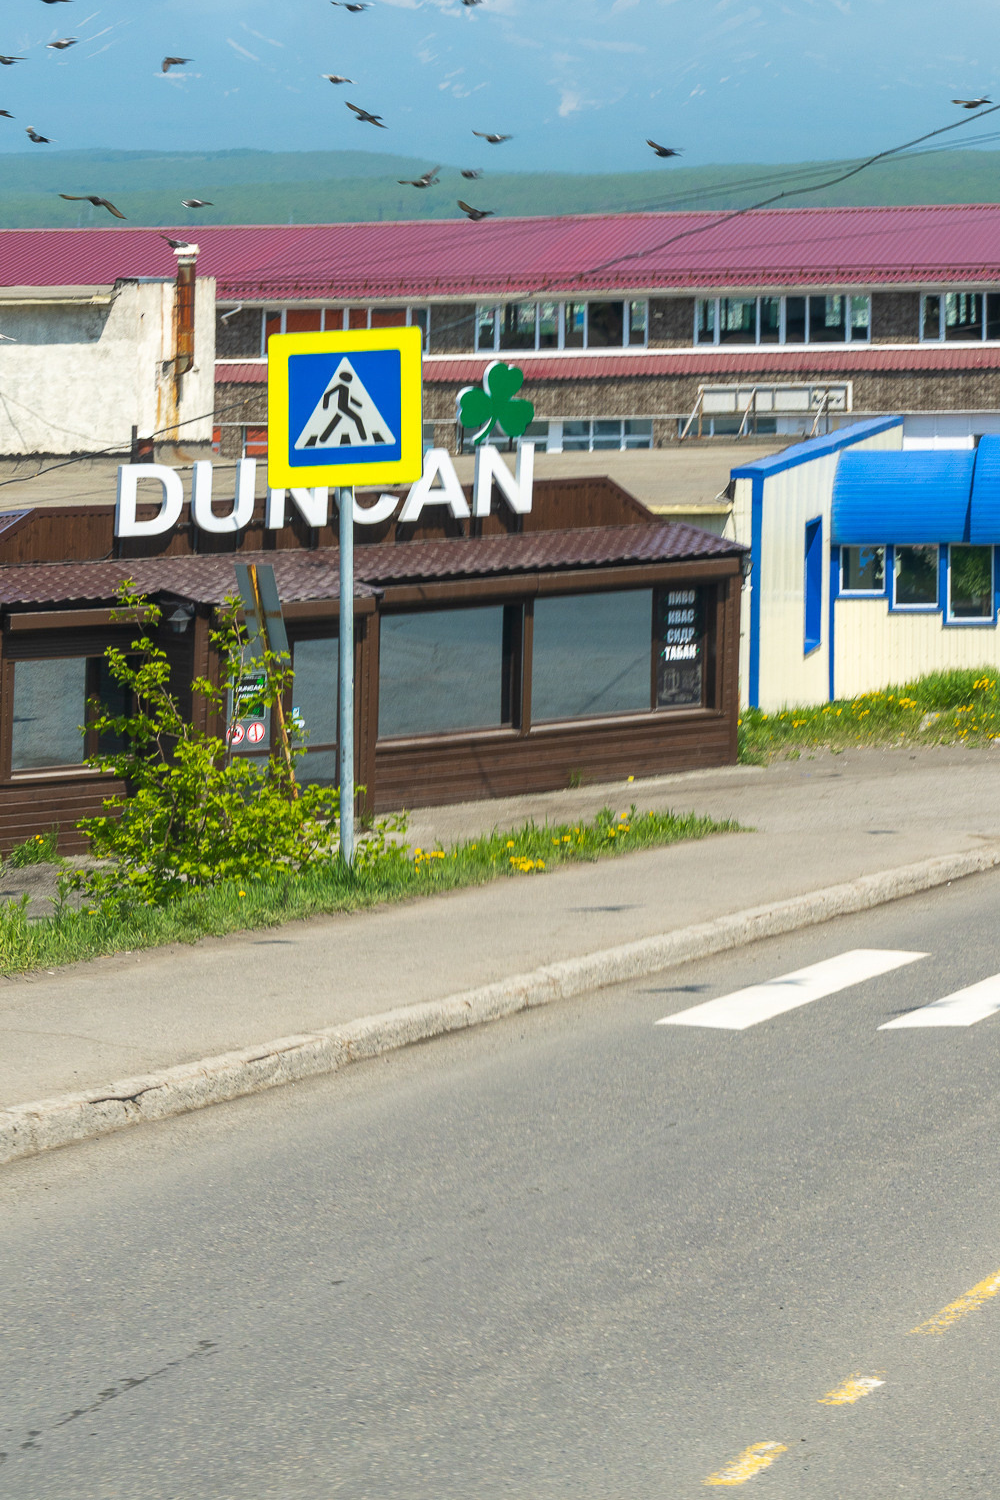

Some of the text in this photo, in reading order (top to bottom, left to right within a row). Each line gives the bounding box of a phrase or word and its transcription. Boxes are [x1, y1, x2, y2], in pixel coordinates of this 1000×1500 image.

[668, 590, 695, 606] ПИВО
[667, 609, 695, 625] КВАС
[667, 627, 695, 644] СИДР
[664, 644, 697, 661] ТАБАК
